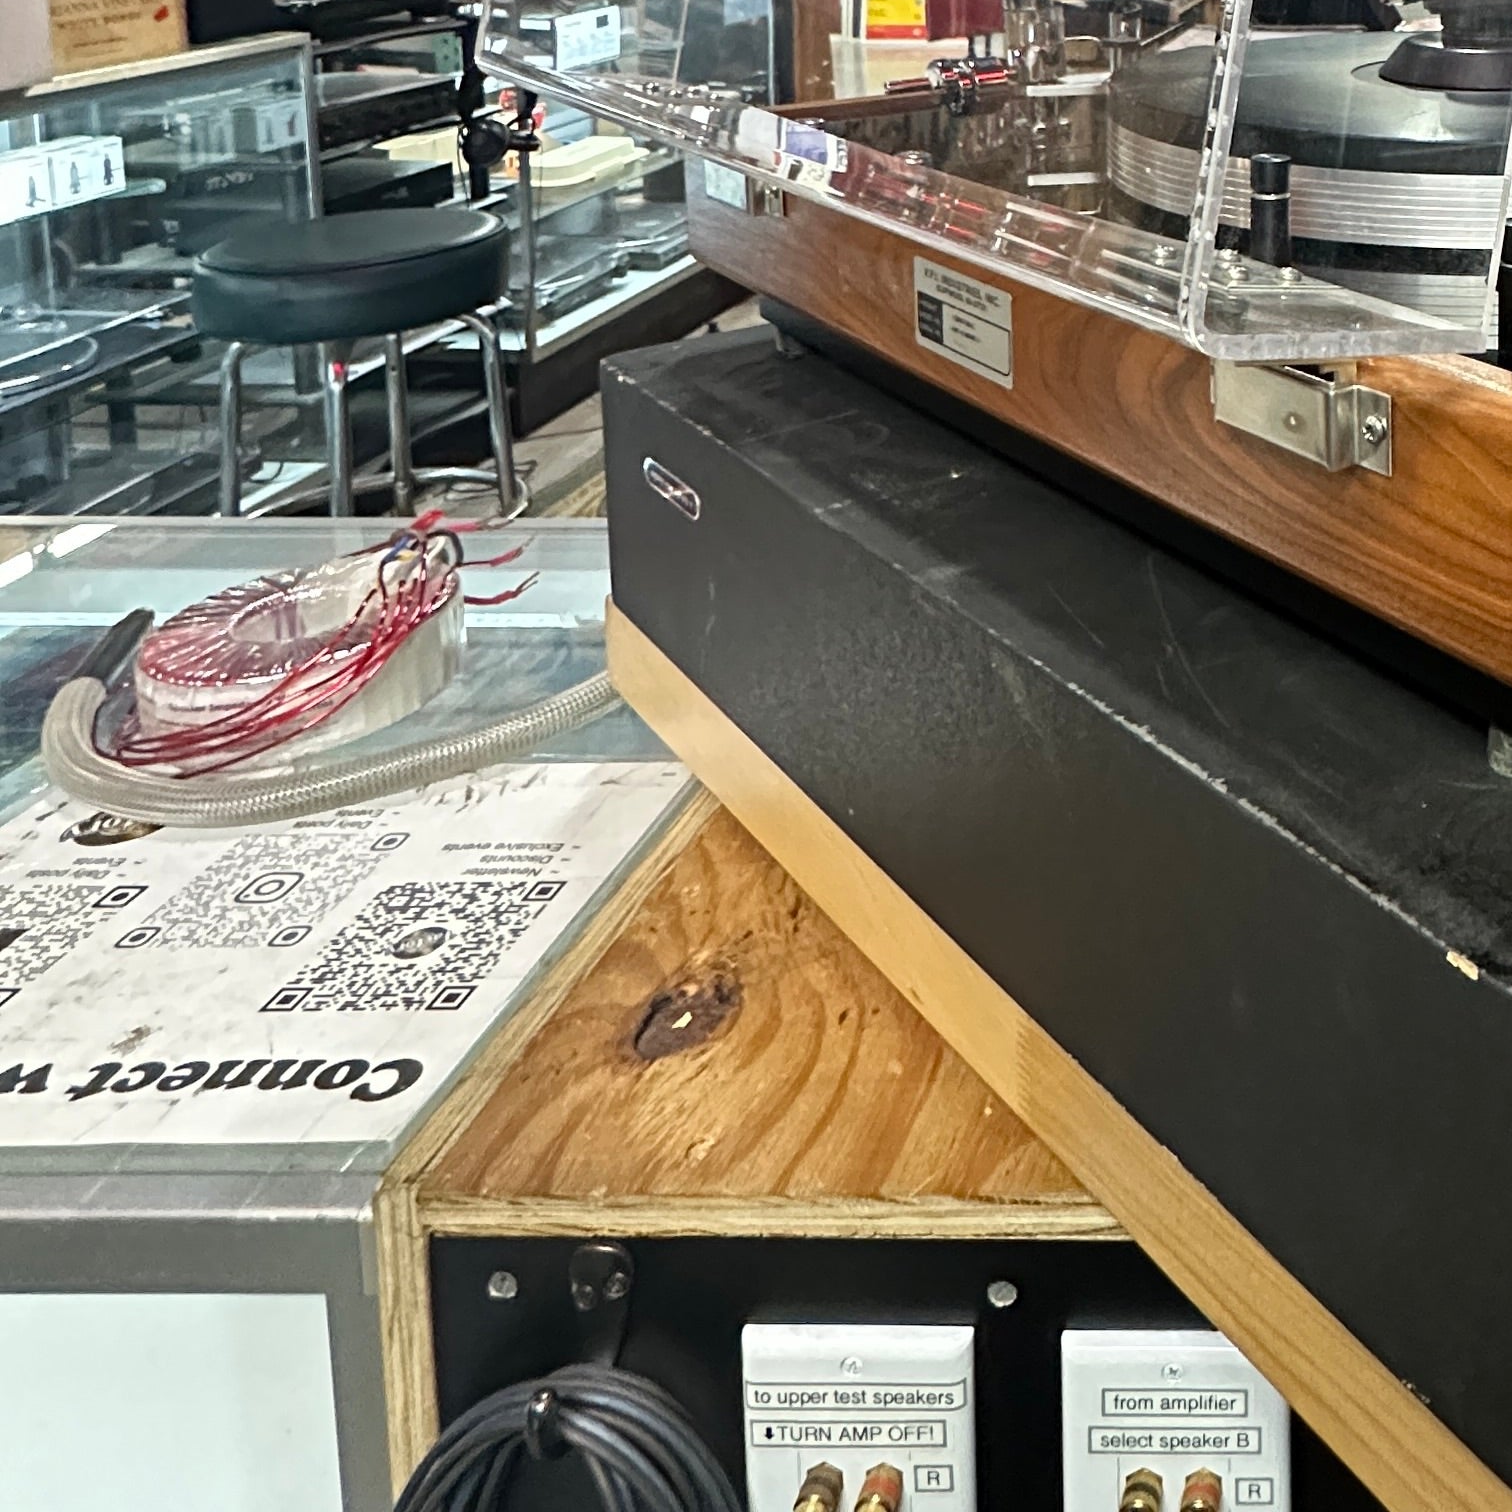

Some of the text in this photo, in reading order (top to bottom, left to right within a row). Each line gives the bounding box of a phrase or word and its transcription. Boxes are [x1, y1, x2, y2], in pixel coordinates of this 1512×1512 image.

[441, 842, 565, 853] Exclusive events
[480, 854, 555, 865] Discounts
[461, 867, 544, 877] Newsletter
[65, 1058, 424, 1103] Connect
[754, 1390, 955, 1408] to upper test speakers
[1114, 1394, 1237, 1413] from amplifier
[777, 1425, 934, 1442] TURN AMP OFF!
[1100, 1432, 1250, 1451] select speaker B
[927, 1470, 941, 1486] R
[1248, 1483, 1262, 1500] R
